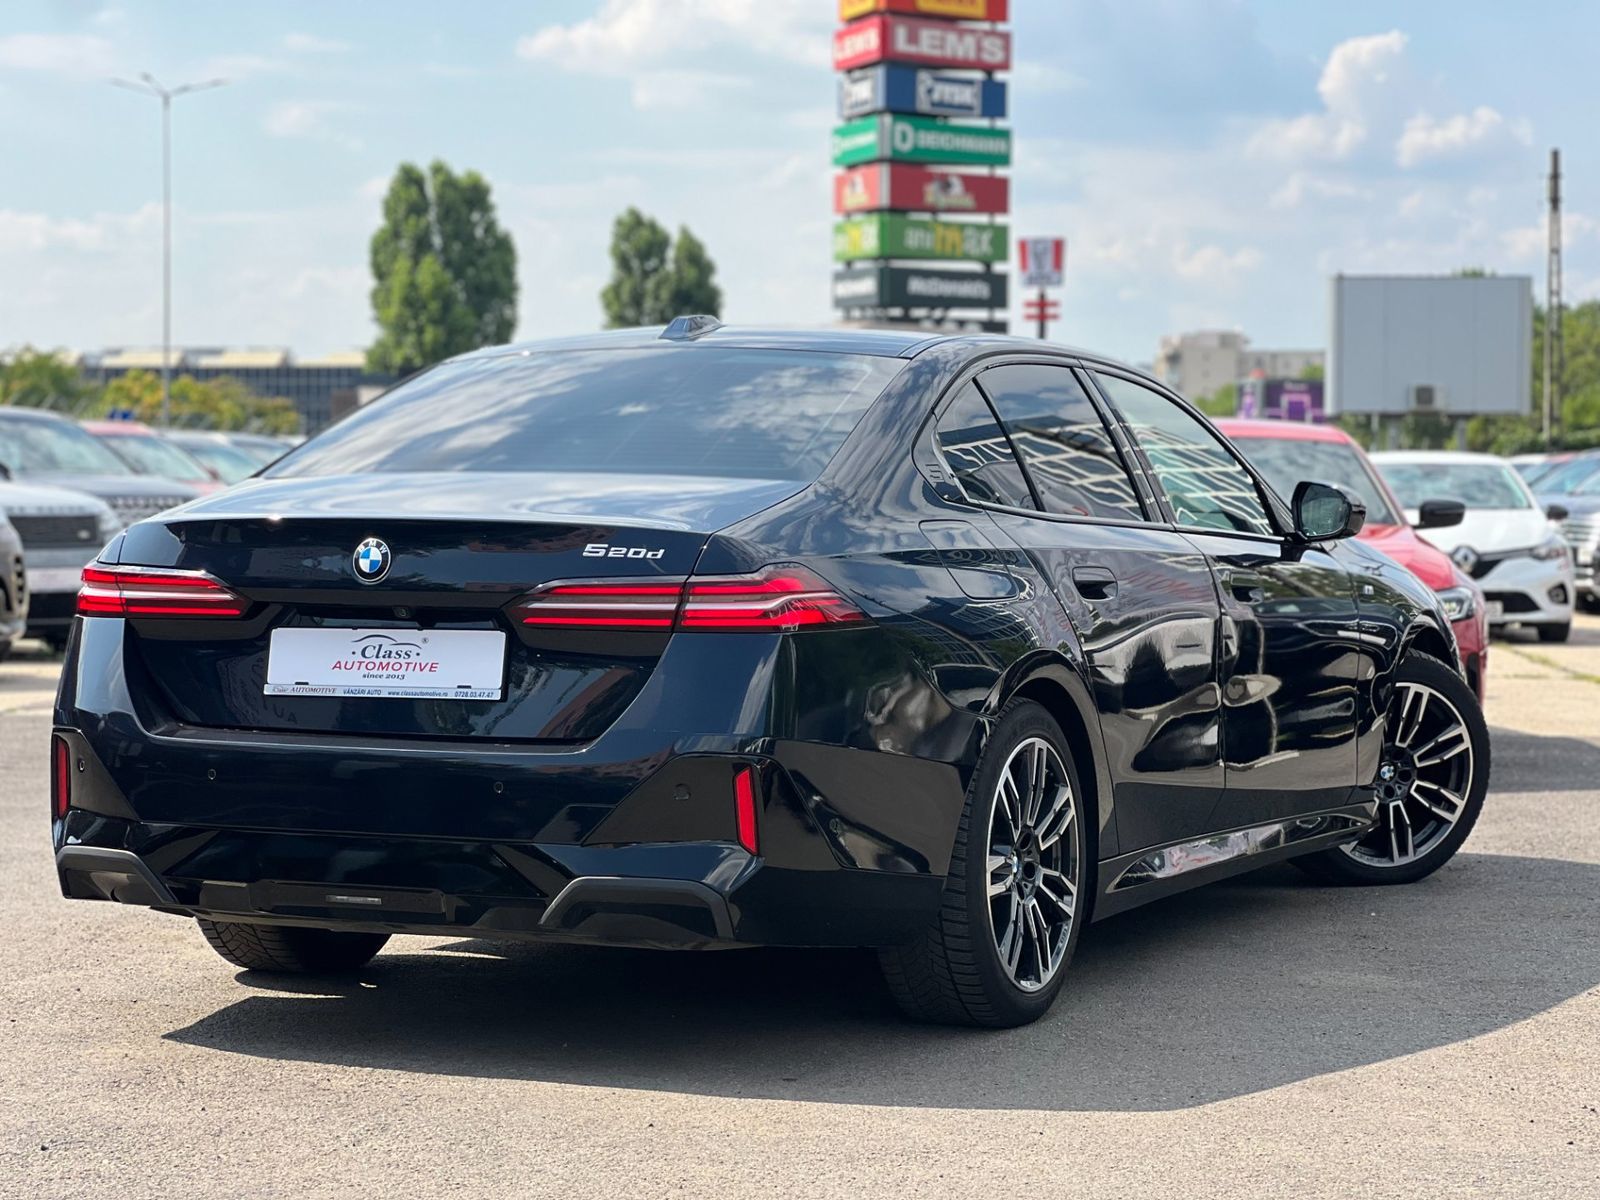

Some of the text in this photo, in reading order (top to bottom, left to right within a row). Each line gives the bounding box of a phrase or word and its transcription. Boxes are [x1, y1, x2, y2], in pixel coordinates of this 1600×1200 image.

[582, 543, 665, 559] 520d
[360, 644, 412, 660] Class
[331, 660, 440, 673] AUTOMOTIVE
[362, 672, 406, 681] since 2013
[290, 686, 338, 694] AUTOMOTIVE
[366, 688, 382, 696] AUTO
[387, 689, 449, 698] www.classautomotive.ro
[454, 690, 495, 699] 0728.03.47.47
